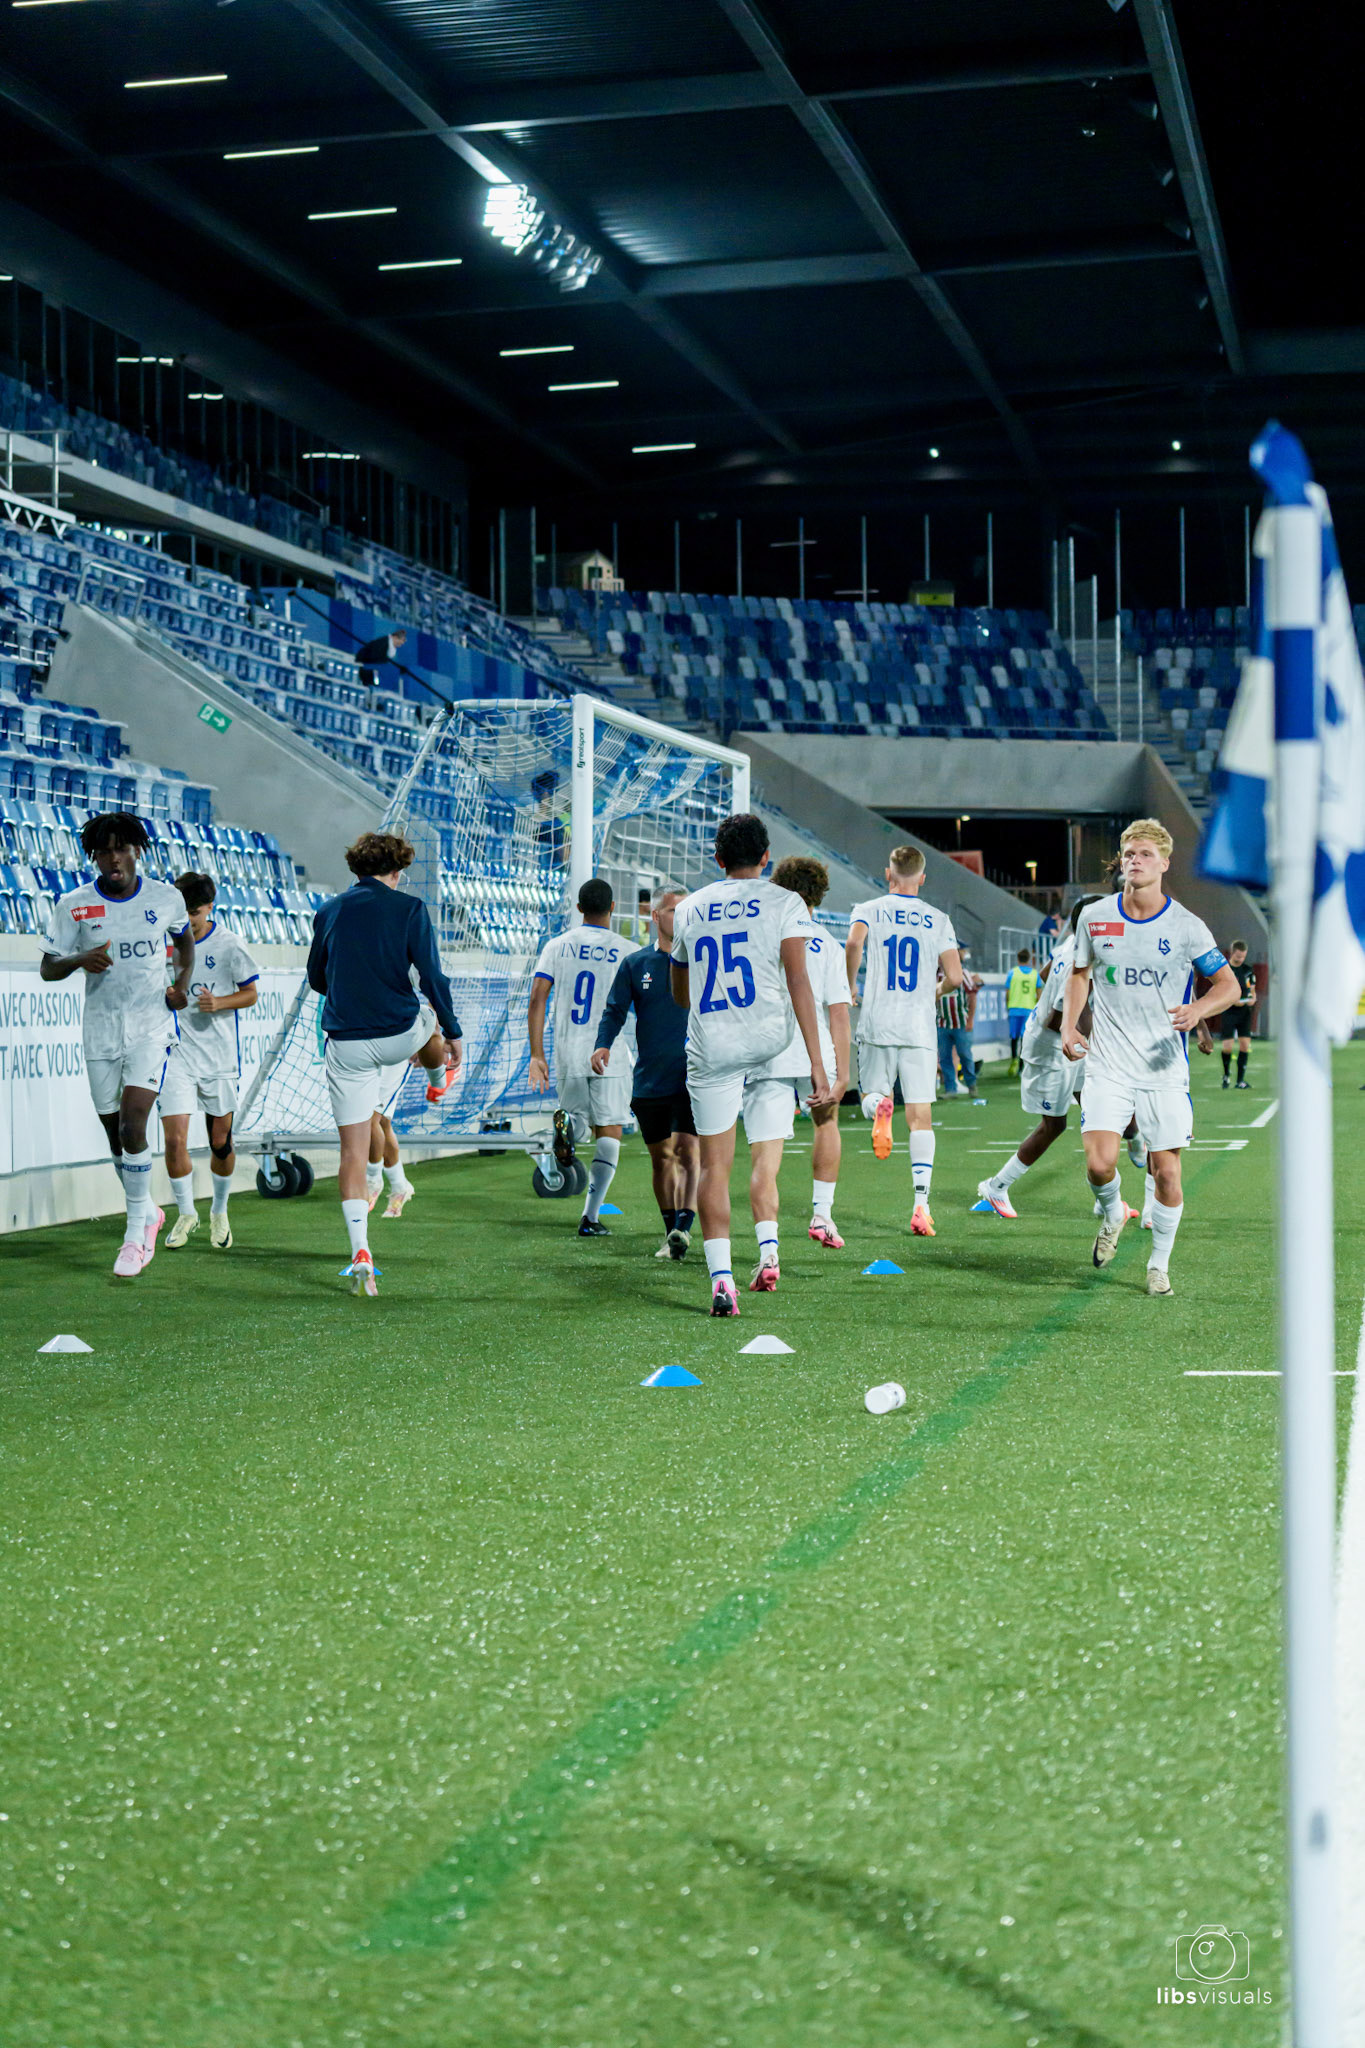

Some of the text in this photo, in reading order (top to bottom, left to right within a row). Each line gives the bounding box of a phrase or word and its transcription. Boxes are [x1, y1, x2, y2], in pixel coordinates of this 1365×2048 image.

[686, 899, 761, 926] INEOS
[875, 909, 933, 929] INEOS
[119, 940, 159, 959] BCV
[561, 942, 619, 963] INEOS
[694, 931, 756, 1015] 25
[883, 934, 920, 992] 19
[186, 982, 216, 997] CV
[1022, 980, 1031, 995] 5
[1125, 967, 1168, 988] BCV
[30, 992, 81, 1027] PASSION
[571, 970, 595, 1025] 9
[11, 1044, 43, 1079] AVEC
[46, 1042, 83, 1077] VOUS!
